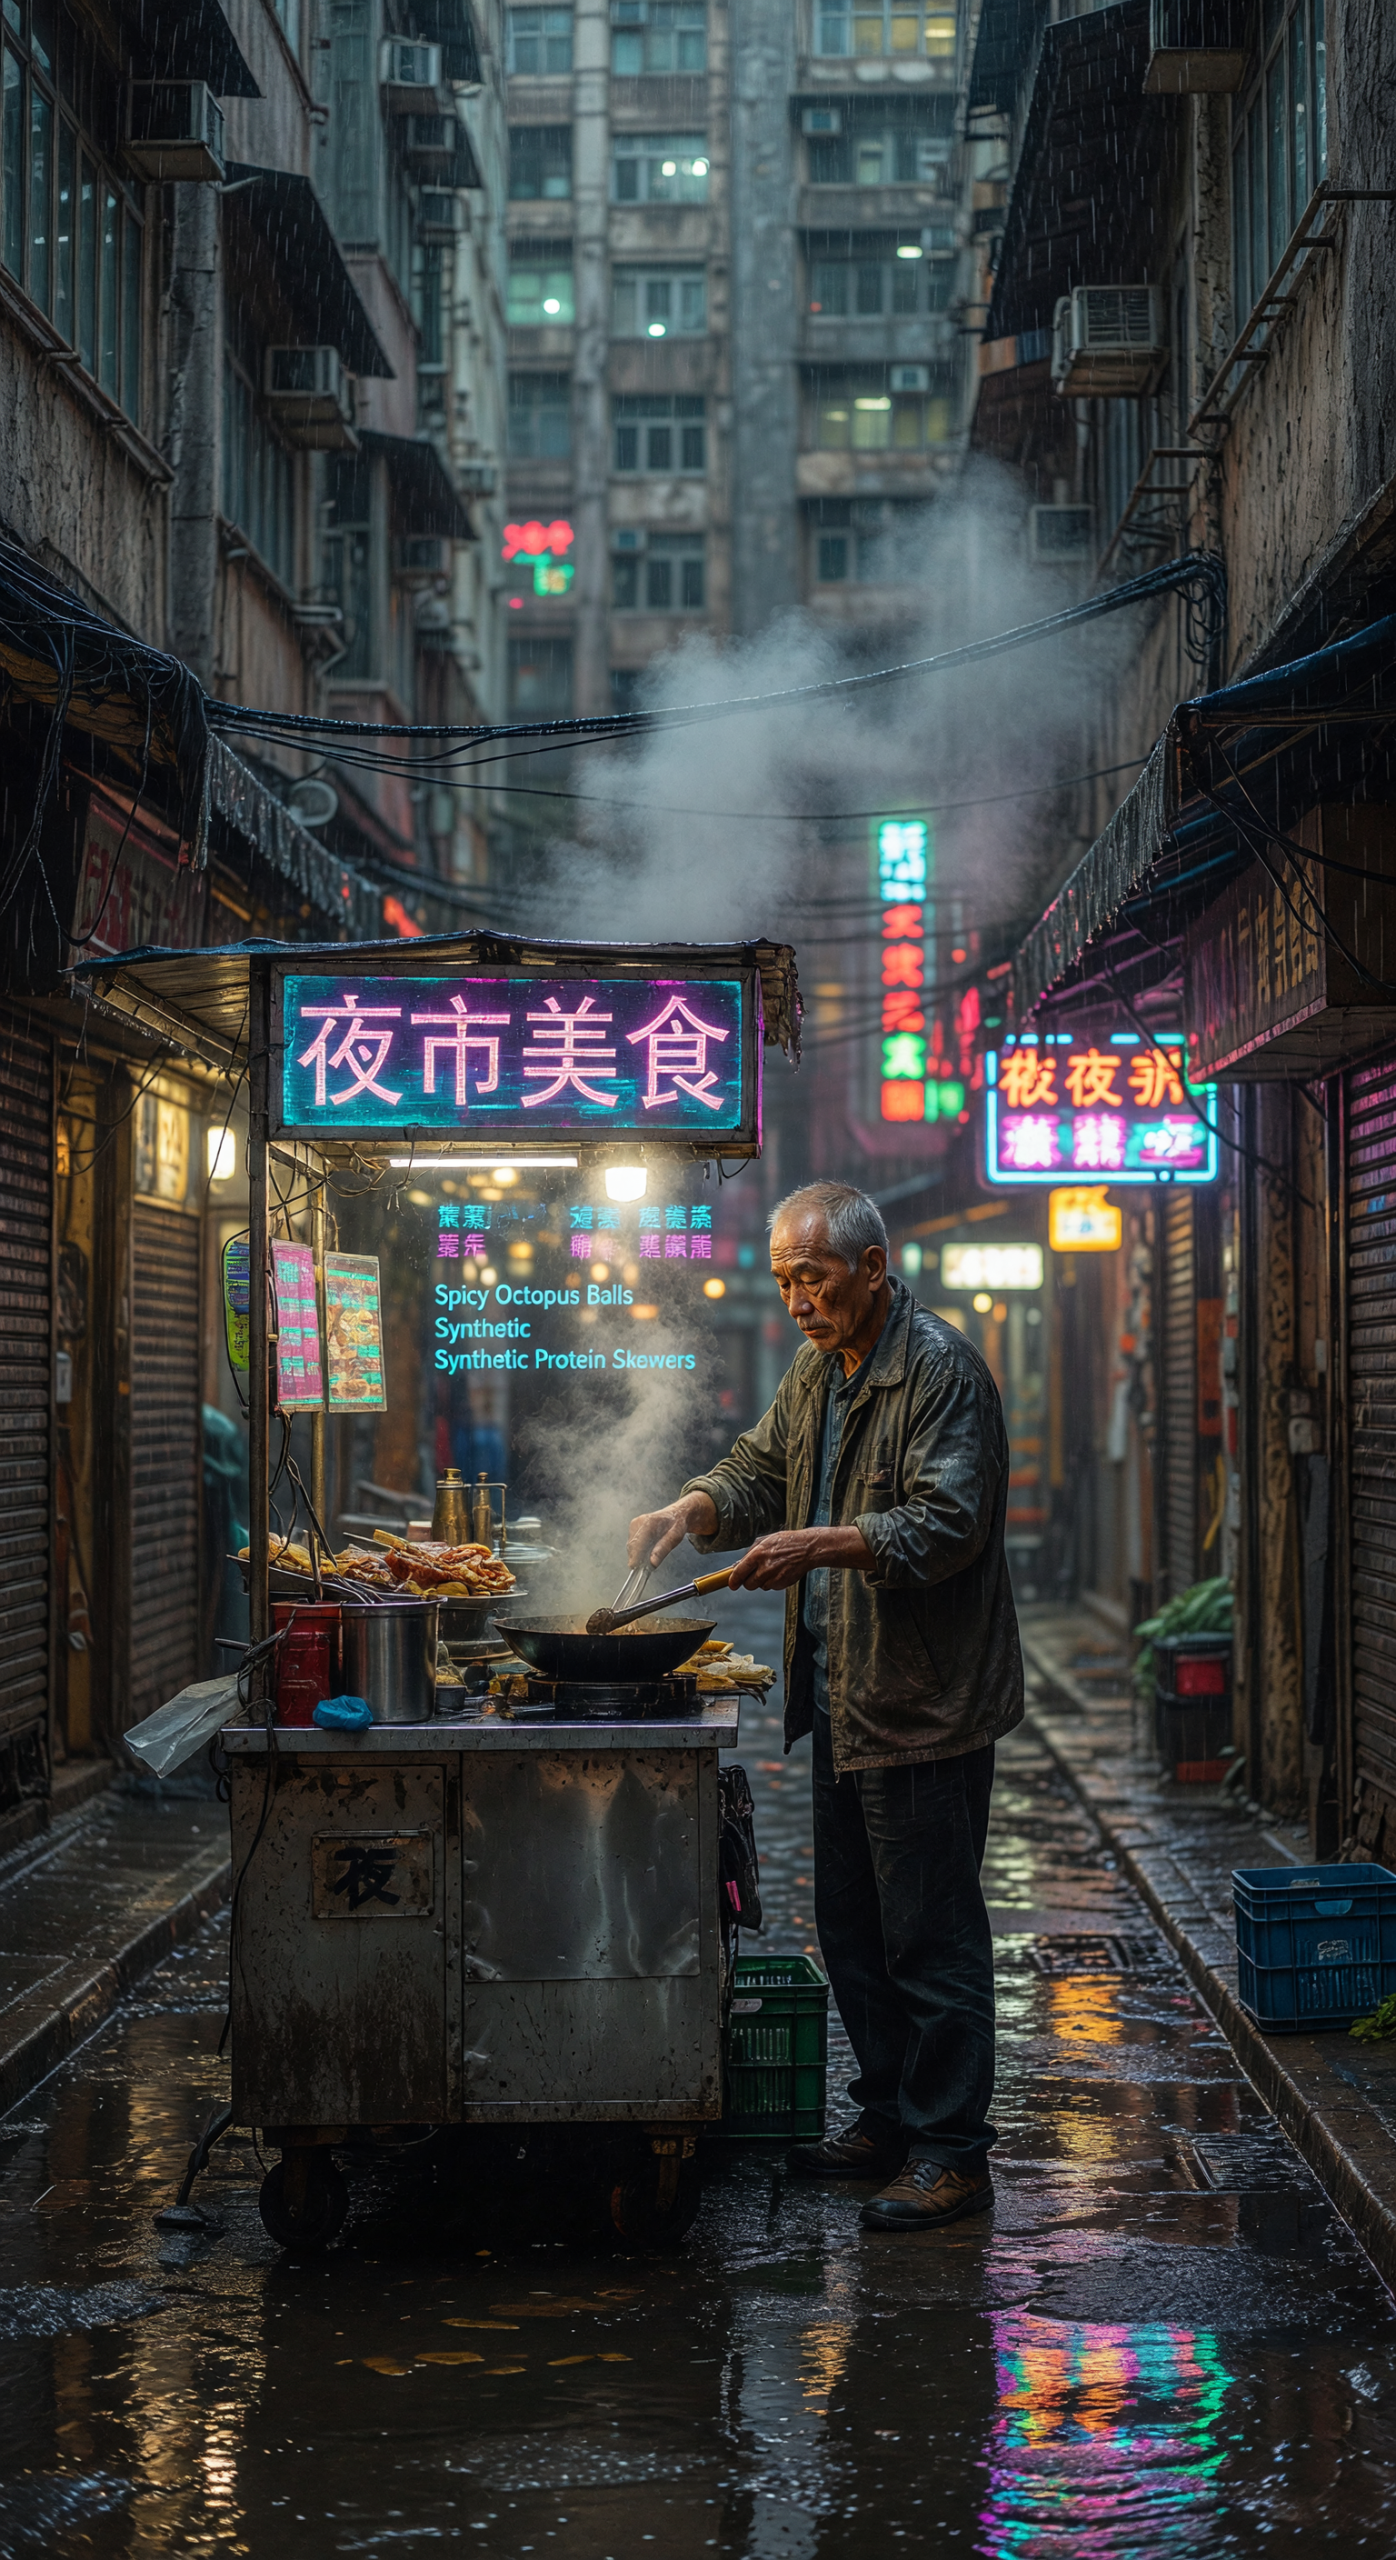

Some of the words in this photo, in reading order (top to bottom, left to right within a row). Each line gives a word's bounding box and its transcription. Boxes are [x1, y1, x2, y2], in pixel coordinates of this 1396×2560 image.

[297, 993, 730, 1110] 夜市美食
[434, 1283, 489, 1311] Spicy
[494, 1283, 580, 1310] Octopus
[587, 1283, 634, 1305] Balls
[434, 1316, 531, 1344] Synthetic
[434, 1348, 529, 1375] Synthetic
[535, 1348, 606, 1370] Protein
[612, 1348, 696, 1370] Skewers
[333, 1847, 402, 1911] 夜
